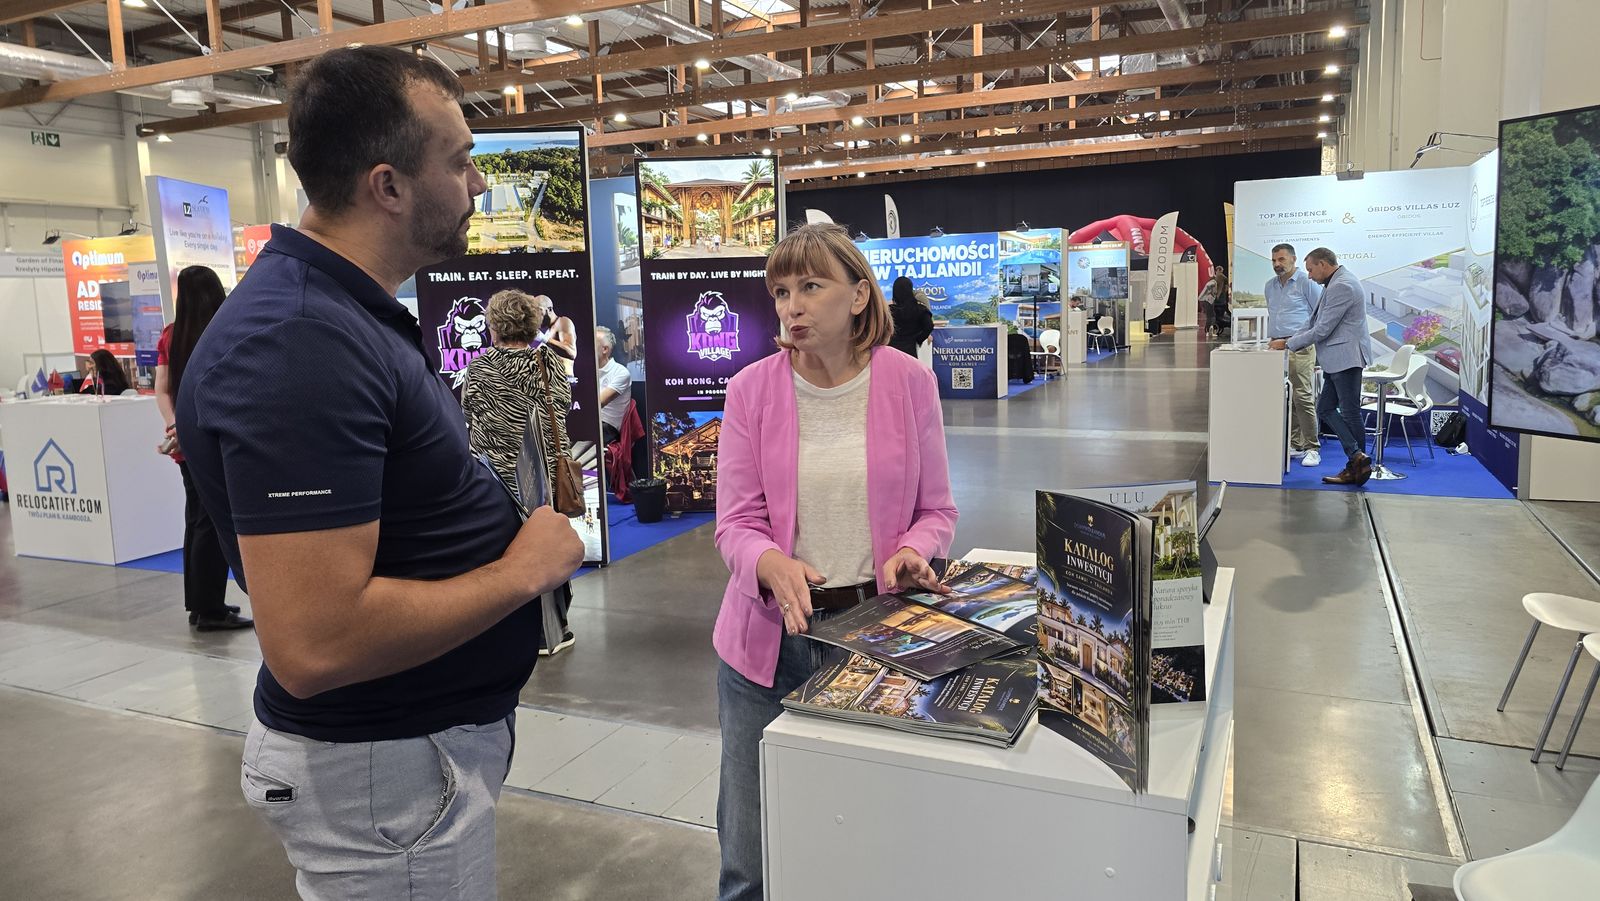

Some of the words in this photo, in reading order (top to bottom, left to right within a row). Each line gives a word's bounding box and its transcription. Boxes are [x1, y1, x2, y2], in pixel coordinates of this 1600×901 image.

[1278, 210, 1328, 218] RESIDENCE
[1367, 204, 1402, 213] ÓBIDOS
[1405, 203, 1439, 211] VILLAS
[1342, 212, 1356, 225] &
[1157, 225, 1169, 277] IZODOM
[1336, 252, 1376, 260] RTUGAL
[72, 250, 124, 270] Optimum
[428, 272, 465, 282] TRAIN.
[468, 271, 493, 281] EAT.
[496, 270, 532, 280] SLEEP.
[535, 269, 579, 279] REPEAT.
[651, 272, 676, 280] TRAIN
[678, 271, 689, 280] BY
[690, 271, 709, 279] DAY.
[711, 270, 729, 279] LIVE
[731, 270, 741, 278] BY
[873, 265, 892, 280] W
[895, 261, 982, 279] TAJLANDII
[690, 332, 736, 350] KONG
[699, 348, 731, 357] VILLAGE
[665, 378, 684, 386] KOH
[687, 378, 715, 386] RONG,
[718, 377, 733, 385] CA
[291, 489, 332, 497] PERFORMANCE
[1109, 491, 1144, 504] ULU
[16, 494, 102, 514] RELOCATIFY.COM
[1064, 538, 1115, 571] KATALOG
[1066, 554, 1113, 584] INWESTYCJI
[968, 677, 1000, 714] KATALOG
